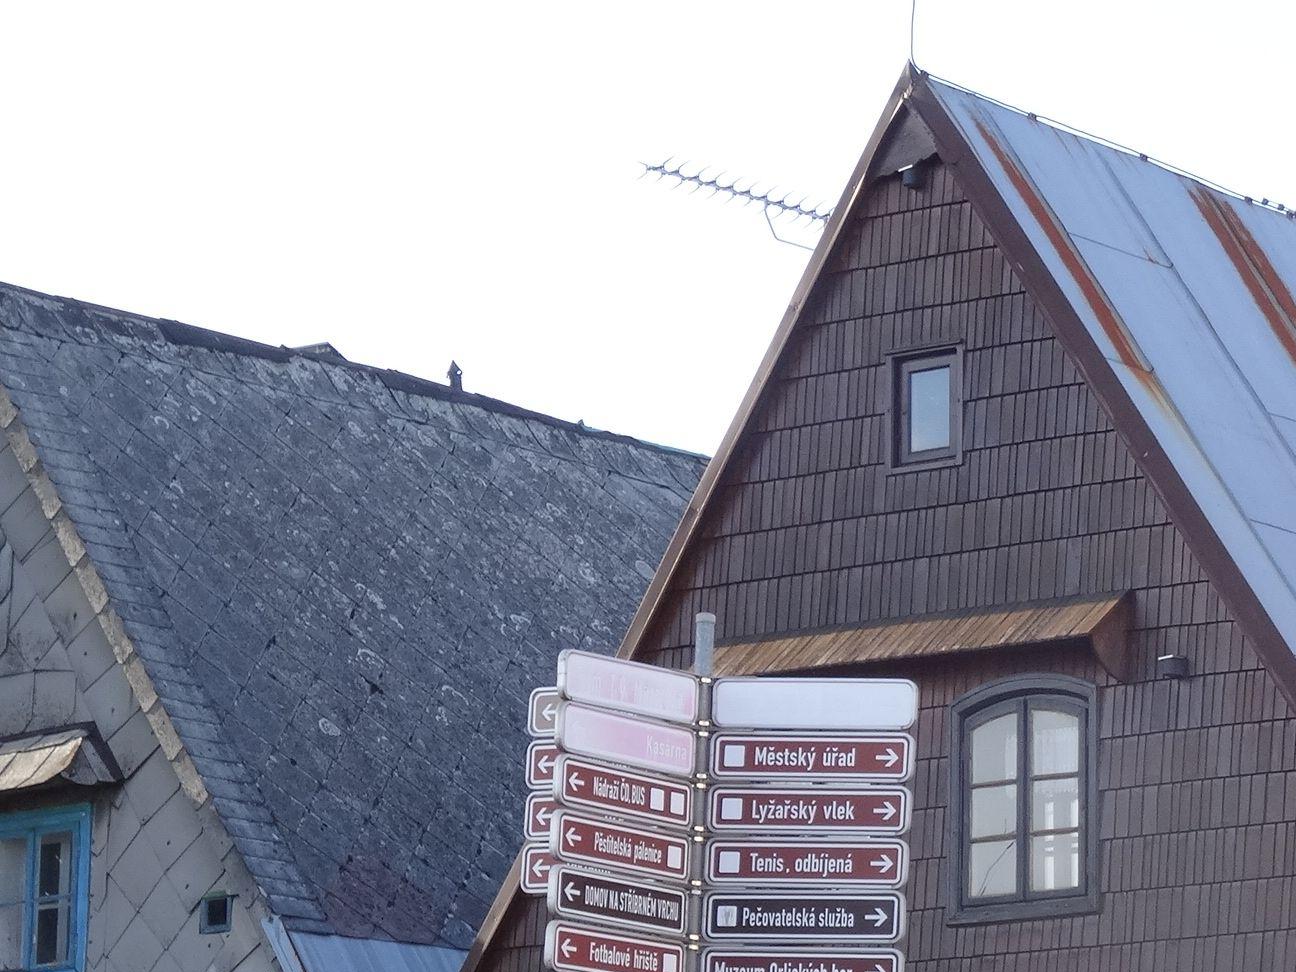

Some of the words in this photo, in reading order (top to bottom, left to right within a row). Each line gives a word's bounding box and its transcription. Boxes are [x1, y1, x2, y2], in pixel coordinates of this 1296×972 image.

[647, 736, 687, 760] Kasarna
[754, 746, 816, 771] Městský
[822, 747, 856, 767] úřad
[593, 776, 619, 800] Nádraží
[631, 784, 646, 806] BUS
[752, 800, 817, 824] Lyžařský
[823, 801, 854, 820] vlek
[594, 831, 632, 858] Pěstitelská
[633, 841, 662, 864] pálenice
[795, 854, 853, 877] odbíjená
[584, 885, 609, 909] DOMOV
[608, 890, 619, 911] NA
[619, 888, 657, 917] STŘÍBRNÉM
[657, 899, 679, 921] VRCHU
[742, 907, 815, 927] Pečovatelská
[818, 907, 854, 928] služba
[589, 942, 630, 967] Fotbalové
[633, 948, 658, 972] hřiště
